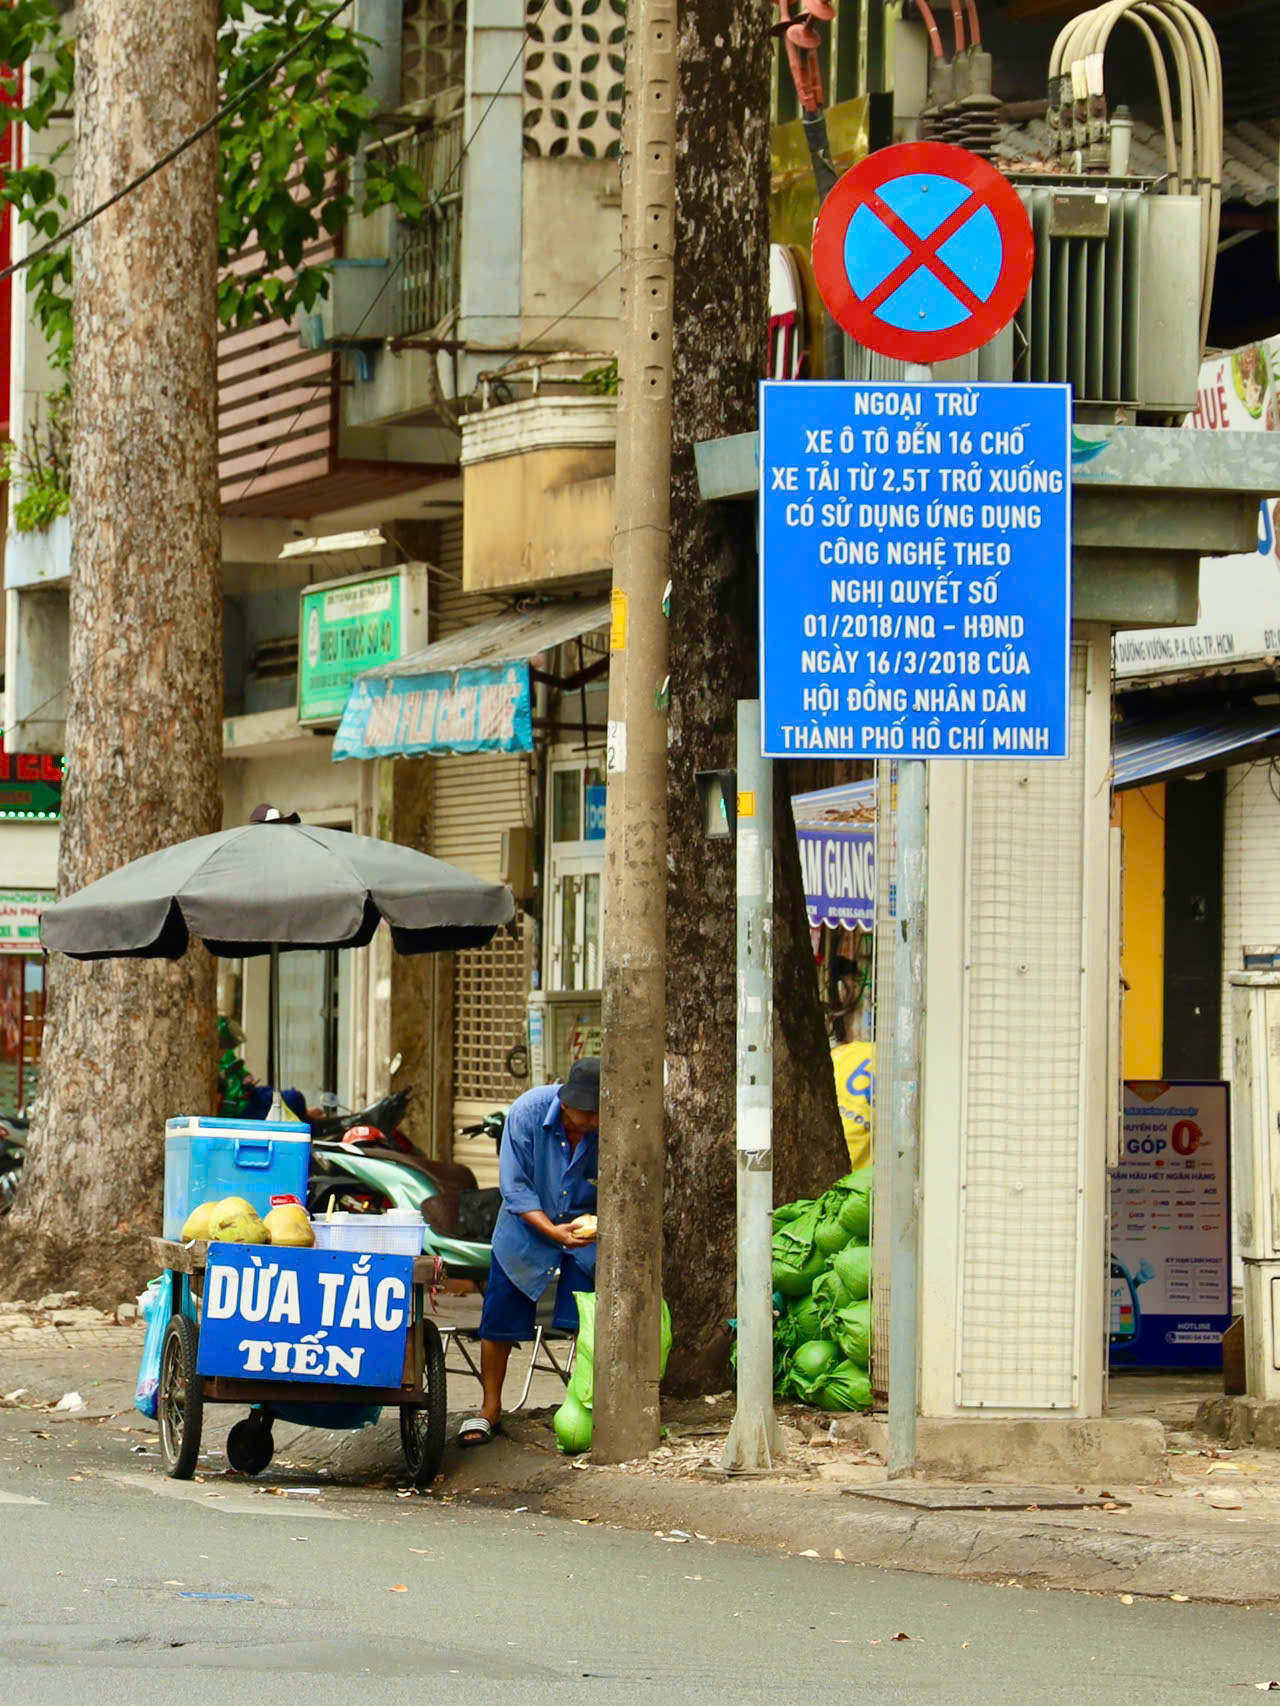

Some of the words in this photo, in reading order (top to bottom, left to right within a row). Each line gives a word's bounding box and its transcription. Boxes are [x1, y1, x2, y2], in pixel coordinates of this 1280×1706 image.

[854, 391, 921, 421] NGOẠI
[935, 386, 981, 417] TRỪ
[805, 429, 833, 455] XE
[839, 425, 855, 455] Ô
[861, 425, 889, 455] TÔ
[896, 421, 941, 456] ĐẾN
[949, 430, 973, 455] 16
[980, 422, 1031, 456] CHỖ
[771, 466, 799, 491] XE
[805, 460, 840, 492] TẢI
[847, 462, 877, 492] TỪ
[882, 468, 931, 495] 2,5T
[938, 460, 982, 493] TRỞ
[989, 460, 1063, 493] XUỐNG
[785, 498, 815, 528] CÓ
[821, 496, 853, 528] SỬ
[859, 504, 920, 534] DỤNG
[926, 498, 974, 528] ỨNG
[981, 504, 1041, 534] DỤNG
[819, 536, 879, 566] CÔNG
[887, 536, 947, 571] NGHỆ
[953, 541, 1011, 566] THEO
[831, 579, 884, 609] NGHỊ
[890, 571, 963, 604] QUYẾT
[967, 571, 1001, 604] SỐ
[804, 614, 936, 640] 01/2018/NQ
[964, 614, 1025, 639] HĐND
[801, 643, 859, 675] NGÀY
[866, 650, 981, 676] 16/3/2018
[987, 644, 1031, 675] CỦA
[803, 684, 840, 719] HỘI
[846, 679, 908, 713] ĐỒNG
[915, 685, 976, 713] NHÂN
[982, 685, 1027, 713] DÂN
[780, 719, 854, 750] THÀNH
[861, 716, 908, 751] PHỐ
[911, 716, 941, 751] HỒ
[948, 719, 987, 751] CHÍ
[992, 726, 1049, 751] MINH
[824, 838, 874, 901] GIANG
[1126, 1134, 1167, 1154] GÓP
[206, 1255, 301, 1325] DỪA
[318, 1254, 407, 1332] TẮC
[238, 1330, 366, 1378] TIẾN
